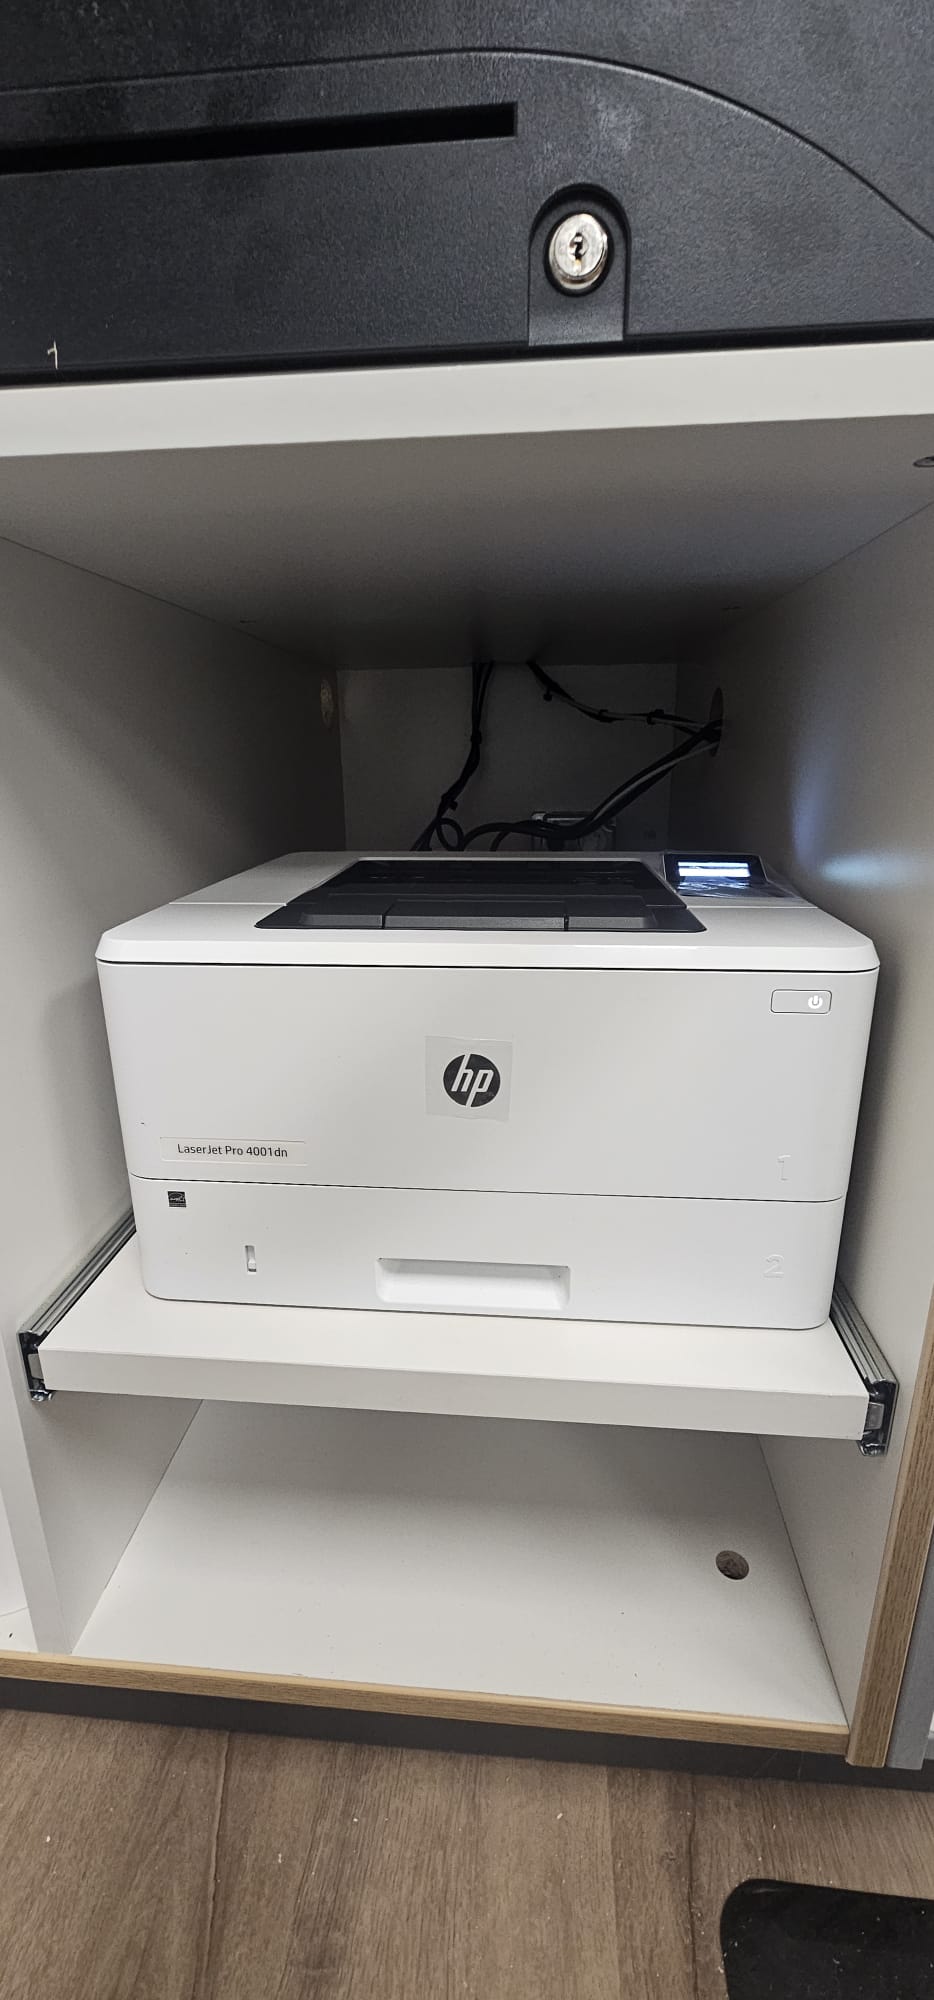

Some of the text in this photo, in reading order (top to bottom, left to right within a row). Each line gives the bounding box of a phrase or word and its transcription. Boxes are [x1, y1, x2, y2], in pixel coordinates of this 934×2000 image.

[450, 1053, 495, 1108] hp
[177, 1143, 288, 1158] LaserJet Pro 4001dn
[776, 1154, 792, 1182] 1
[762, 1254, 785, 1279] 2
